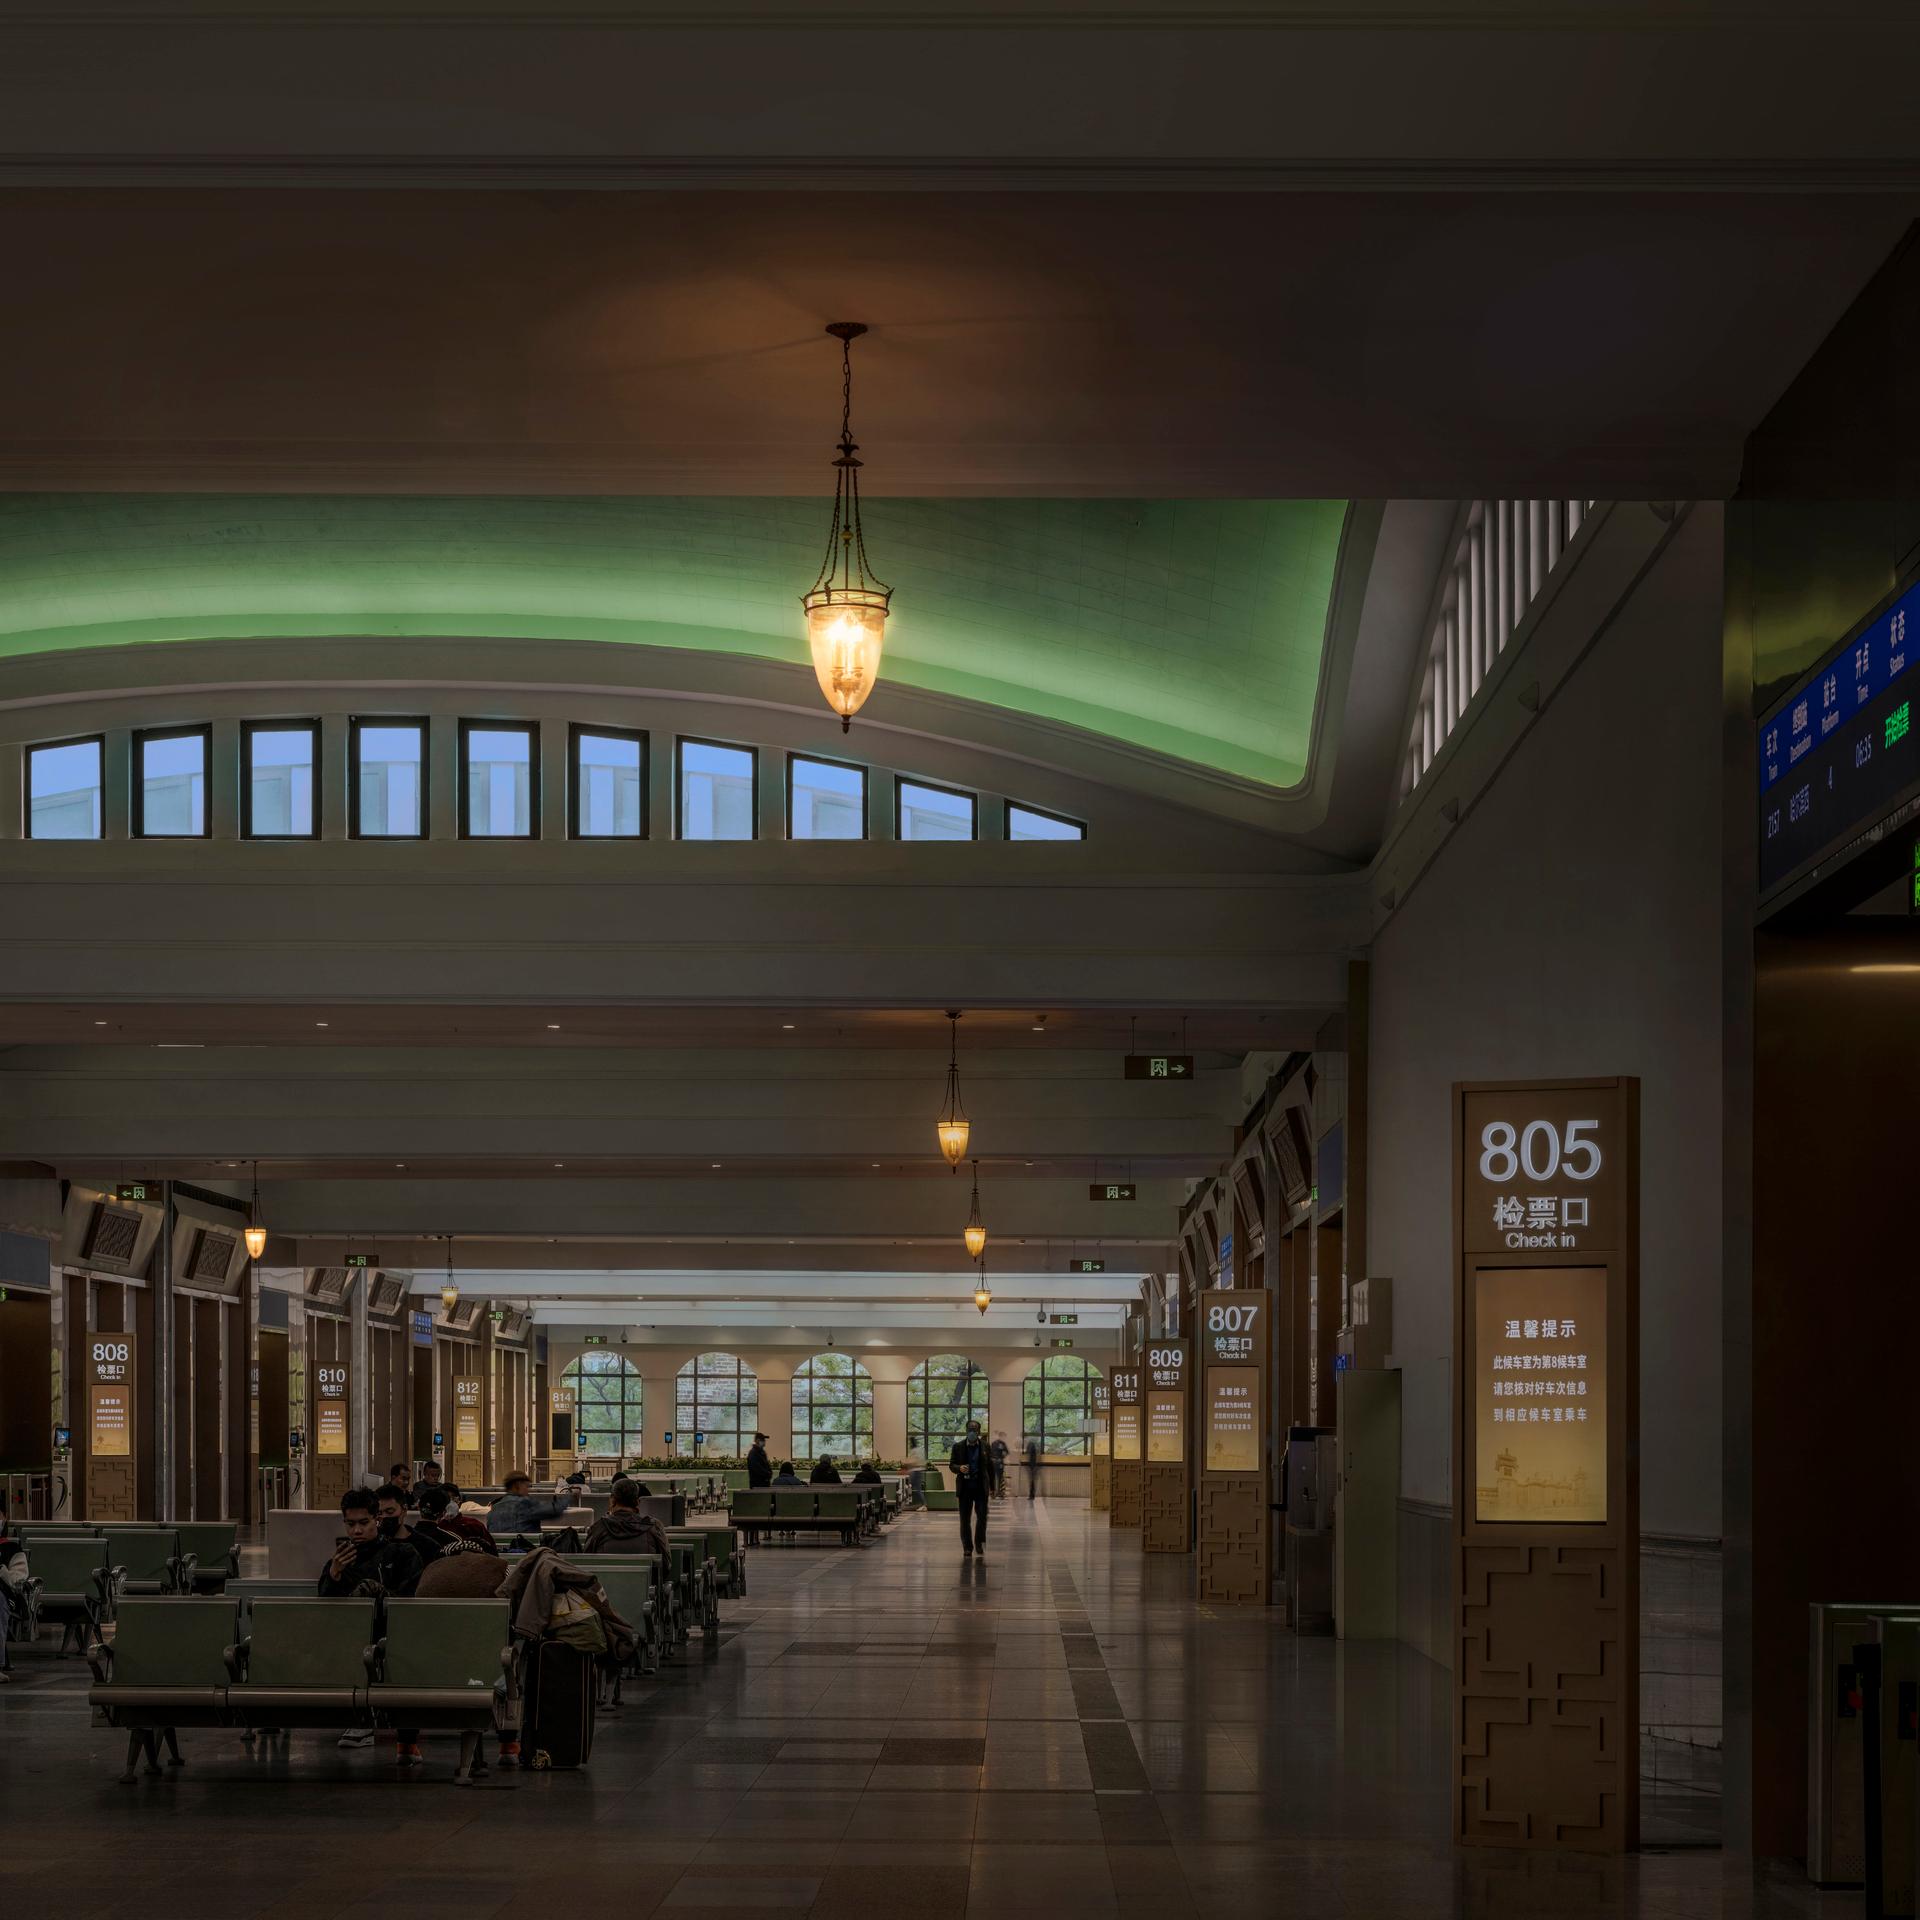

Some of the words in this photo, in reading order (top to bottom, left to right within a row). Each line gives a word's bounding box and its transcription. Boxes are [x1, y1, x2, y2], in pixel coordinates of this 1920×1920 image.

[1855, 642, 1870, 680] 开点
[1890, 609, 1905, 648] 状态
[1480, 1119, 1602, 1182] 805
[1492, 1195, 1589, 1231] 检票口
[1505, 1231, 1557, 1249] Check
[1560, 1231, 1576, 1248] in
[1208, 1306, 1259, 1332] 807
[1505, 1319, 1577, 1339] 温馨提示
[92, 1343, 129, 1362] 808
[1214, 1336, 1253, 1352] 检票口
[1149, 1349, 1183, 1368] 809
[1493, 1354, 1587, 1370] 此候车室为第8候车室
[319, 1368, 346, 1383] 810
[1114, 1374, 1138, 1388] 811
[457, 1382, 479, 1394] 812
[1493, 1381, 1588, 1396] 请您核对好车次信息
[553, 1392, 571, 1402] 814
[1493, 1407, 1588, 1422] 到相应候车室乘车
